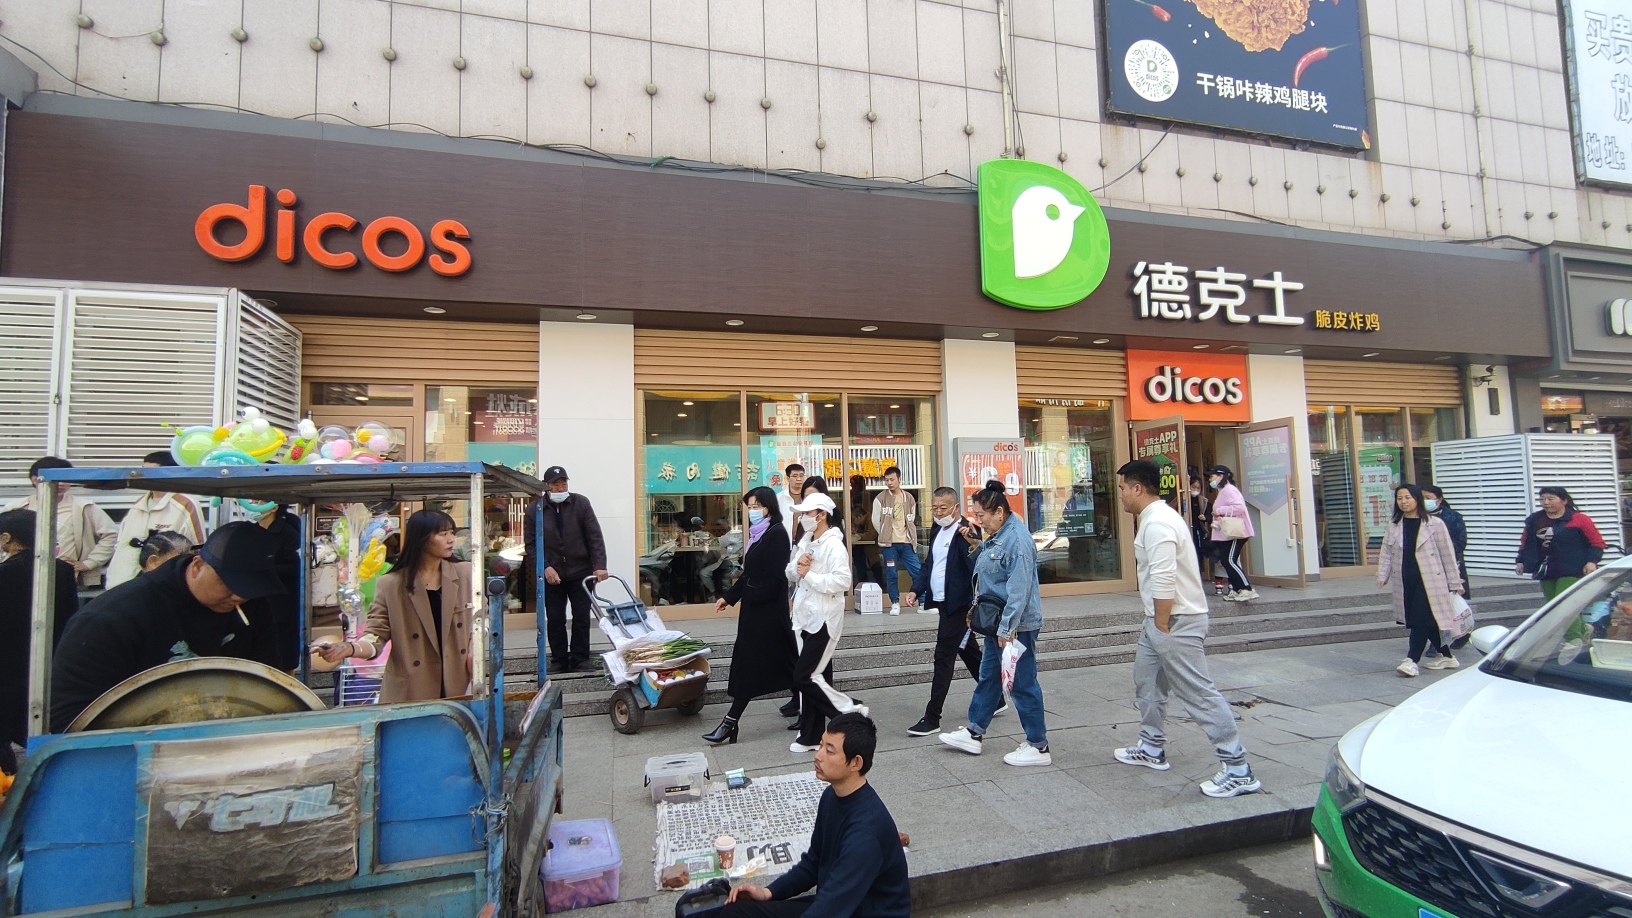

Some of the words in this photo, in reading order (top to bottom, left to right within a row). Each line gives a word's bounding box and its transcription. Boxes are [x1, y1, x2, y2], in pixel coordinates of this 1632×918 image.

[1196, 72, 1328, 114] 干锅咔辣鸡腿块
[194, 184, 472, 277] dicos
[1133, 261, 1304, 326] 德克士
[1315, 309, 1380, 332] 脆皮炸鸡
[1148, 365, 1243, 404] dicos
[993, 442, 1019, 452] dicos
